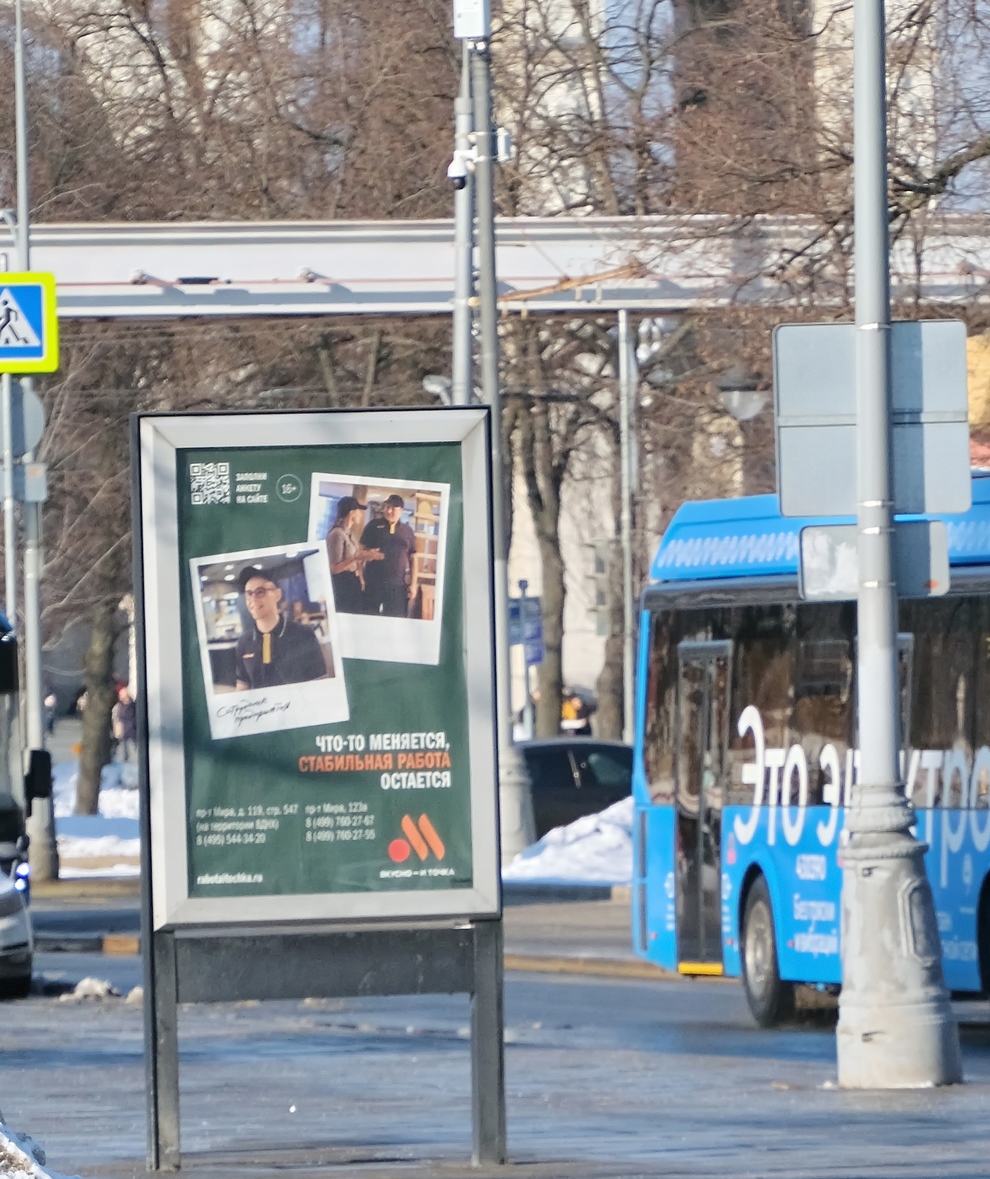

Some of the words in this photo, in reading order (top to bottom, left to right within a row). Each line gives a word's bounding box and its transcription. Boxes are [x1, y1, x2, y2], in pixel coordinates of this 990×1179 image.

[316, 734, 365, 752] ЧТО-ТО
[369, 732, 450, 751] МЕНЯЕТСЯ,
[299, 753, 393, 773] СТАБИЛЬНАЯ
[397, 752, 451, 770] РАБОТА
[380, 771, 451, 790] ОСТАЕТСЯ
[733, 705, 807, 847] Это
